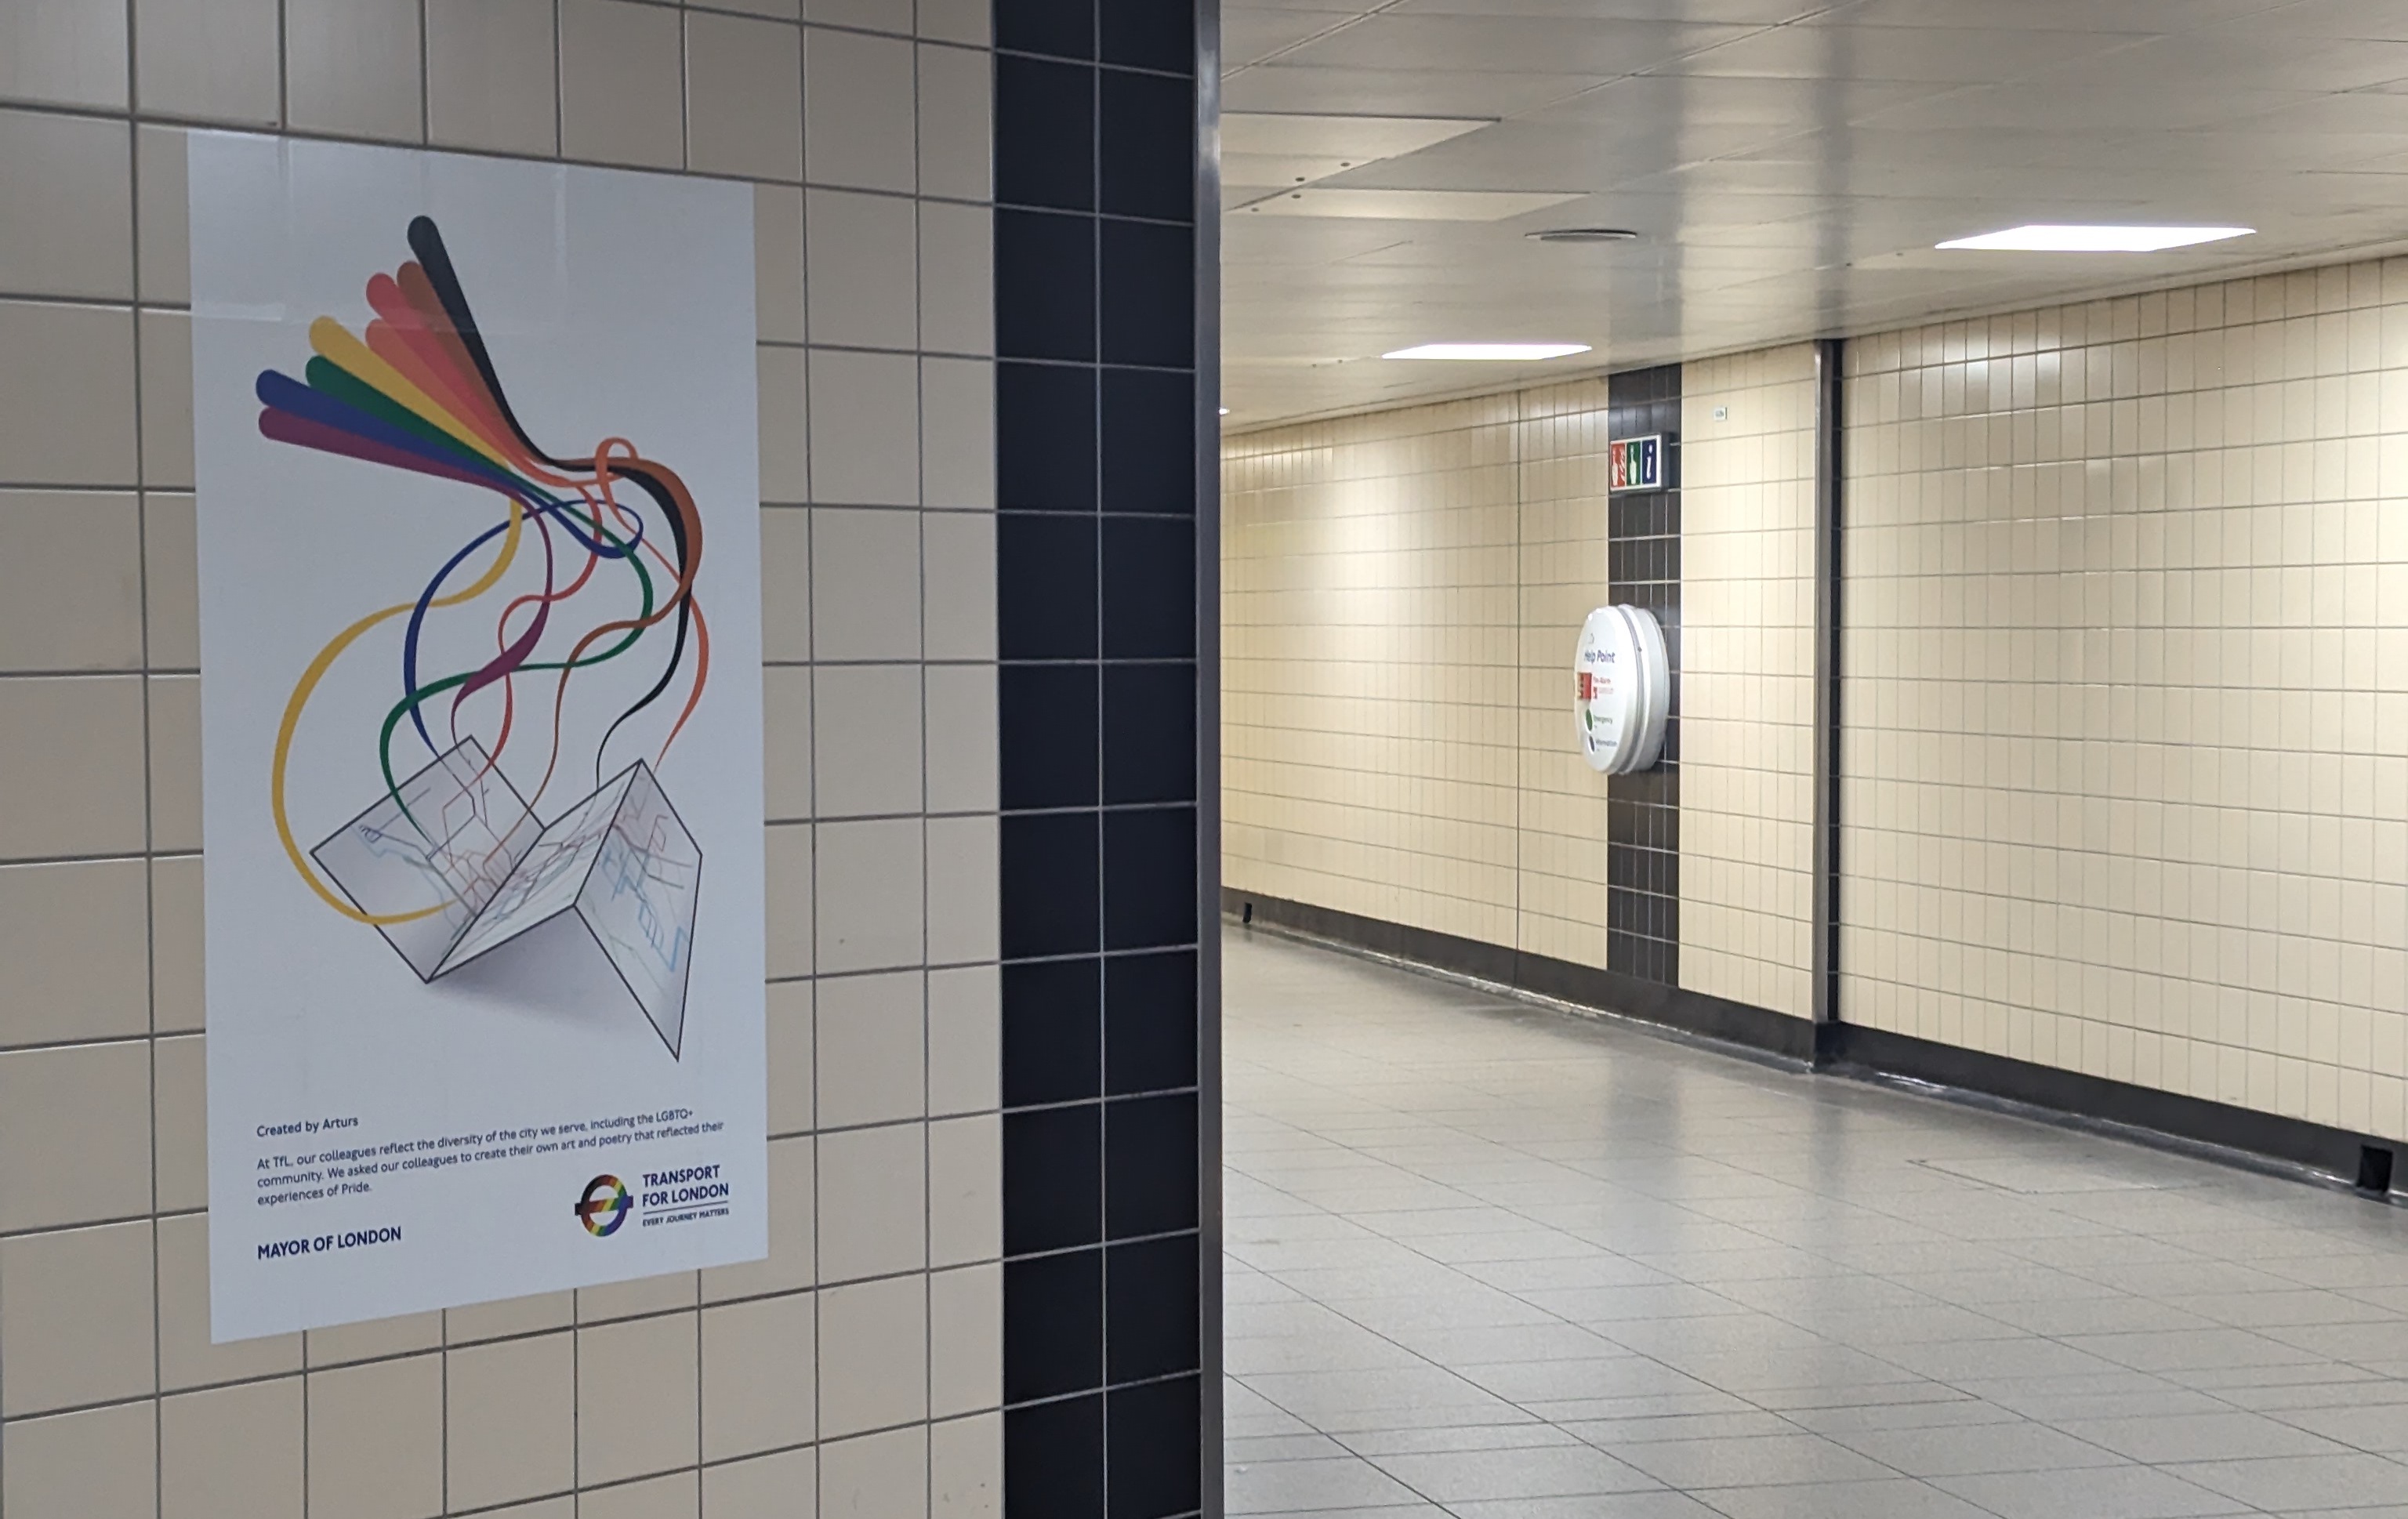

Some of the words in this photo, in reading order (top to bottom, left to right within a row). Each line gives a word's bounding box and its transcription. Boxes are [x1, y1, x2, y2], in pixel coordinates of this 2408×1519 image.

[1597, 650, 1616, 663] Point
[257, 1122, 302, 1137] Created
[306, 1122, 319, 1133] by
[322, 1117, 358, 1129] Arturs
[257, 1158, 270, 1169] At
[297, 1155, 316, 1166] our
[319, 1147, 376, 1162] colleagues
[379, 1142, 414, 1155] reflect
[417, 1139, 434, 1150] the
[437, 1134, 483, 1147] diversity
[485, 1130, 497, 1143] of
[499, 1129, 517, 1140] the
[519, 1128, 538, 1139] city
[541, 1126, 556, 1135] we
[591, 1115, 635, 1129] including
[637, 1113, 654, 1124] the
[656, 1108, 693, 1122] LGBTQ+
[257, 1171, 324, 1187] community.
[328, 1167, 345, 1179] We
[347, 1162, 378, 1176] asked
[381, 1161, 400, 1173] our
[402, 1154, 458, 1169] colleagues
[461, 1152, 471, 1162] to
[474, 1149, 506, 1161] create
[510, 1144, 533, 1156] their
[536, 1142, 558, 1153] own
[561, 1140, 575, 1151] art
[578, 1137, 596, 1148] and
[599, 1133, 632, 1147] poetry
[634, 1129, 655, 1141] that
[657, 1123, 699, 1138] reflected
[702, 1122, 723, 1133] their
[643, 1165, 720, 1187] TRANSPORT
[257, 1189, 324, 1206] experiences
[327, 1184, 338, 1196] of
[643, 1191, 669, 1207] FOR
[672, 1183, 729, 1203] LONDON
[643, 1216, 664, 1227] EVERY
[666, 1211, 697, 1223] JOURNEY
[699, 1208, 729, 1219] MATTERS
[258, 1239, 310, 1260] MAYOR
[314, 1235, 333, 1251] OF
[338, 1226, 401, 1248] LONDON
